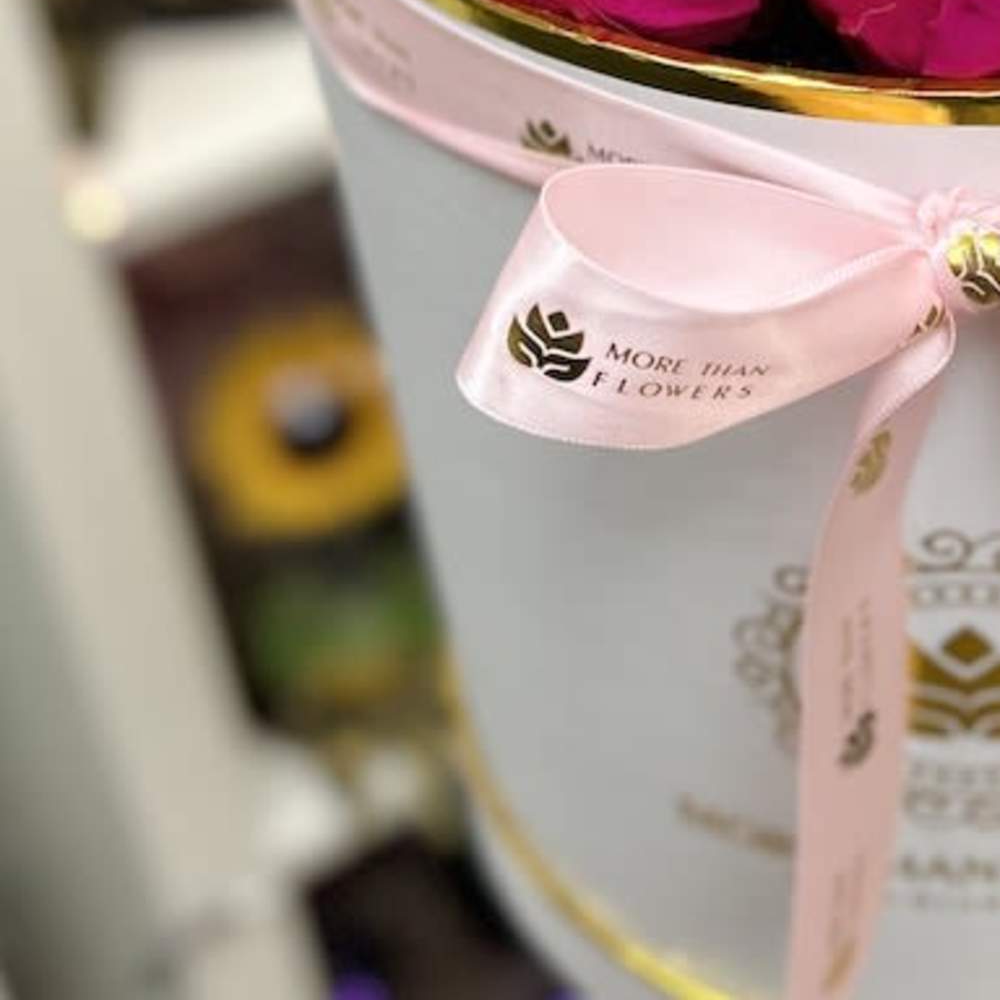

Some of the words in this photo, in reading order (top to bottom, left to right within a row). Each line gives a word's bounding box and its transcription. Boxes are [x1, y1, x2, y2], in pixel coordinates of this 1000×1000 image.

[605, 342, 687, 375] MORE
[702, 361, 770, 376] THAN
[592, 371, 752, 400] FLOWERS
